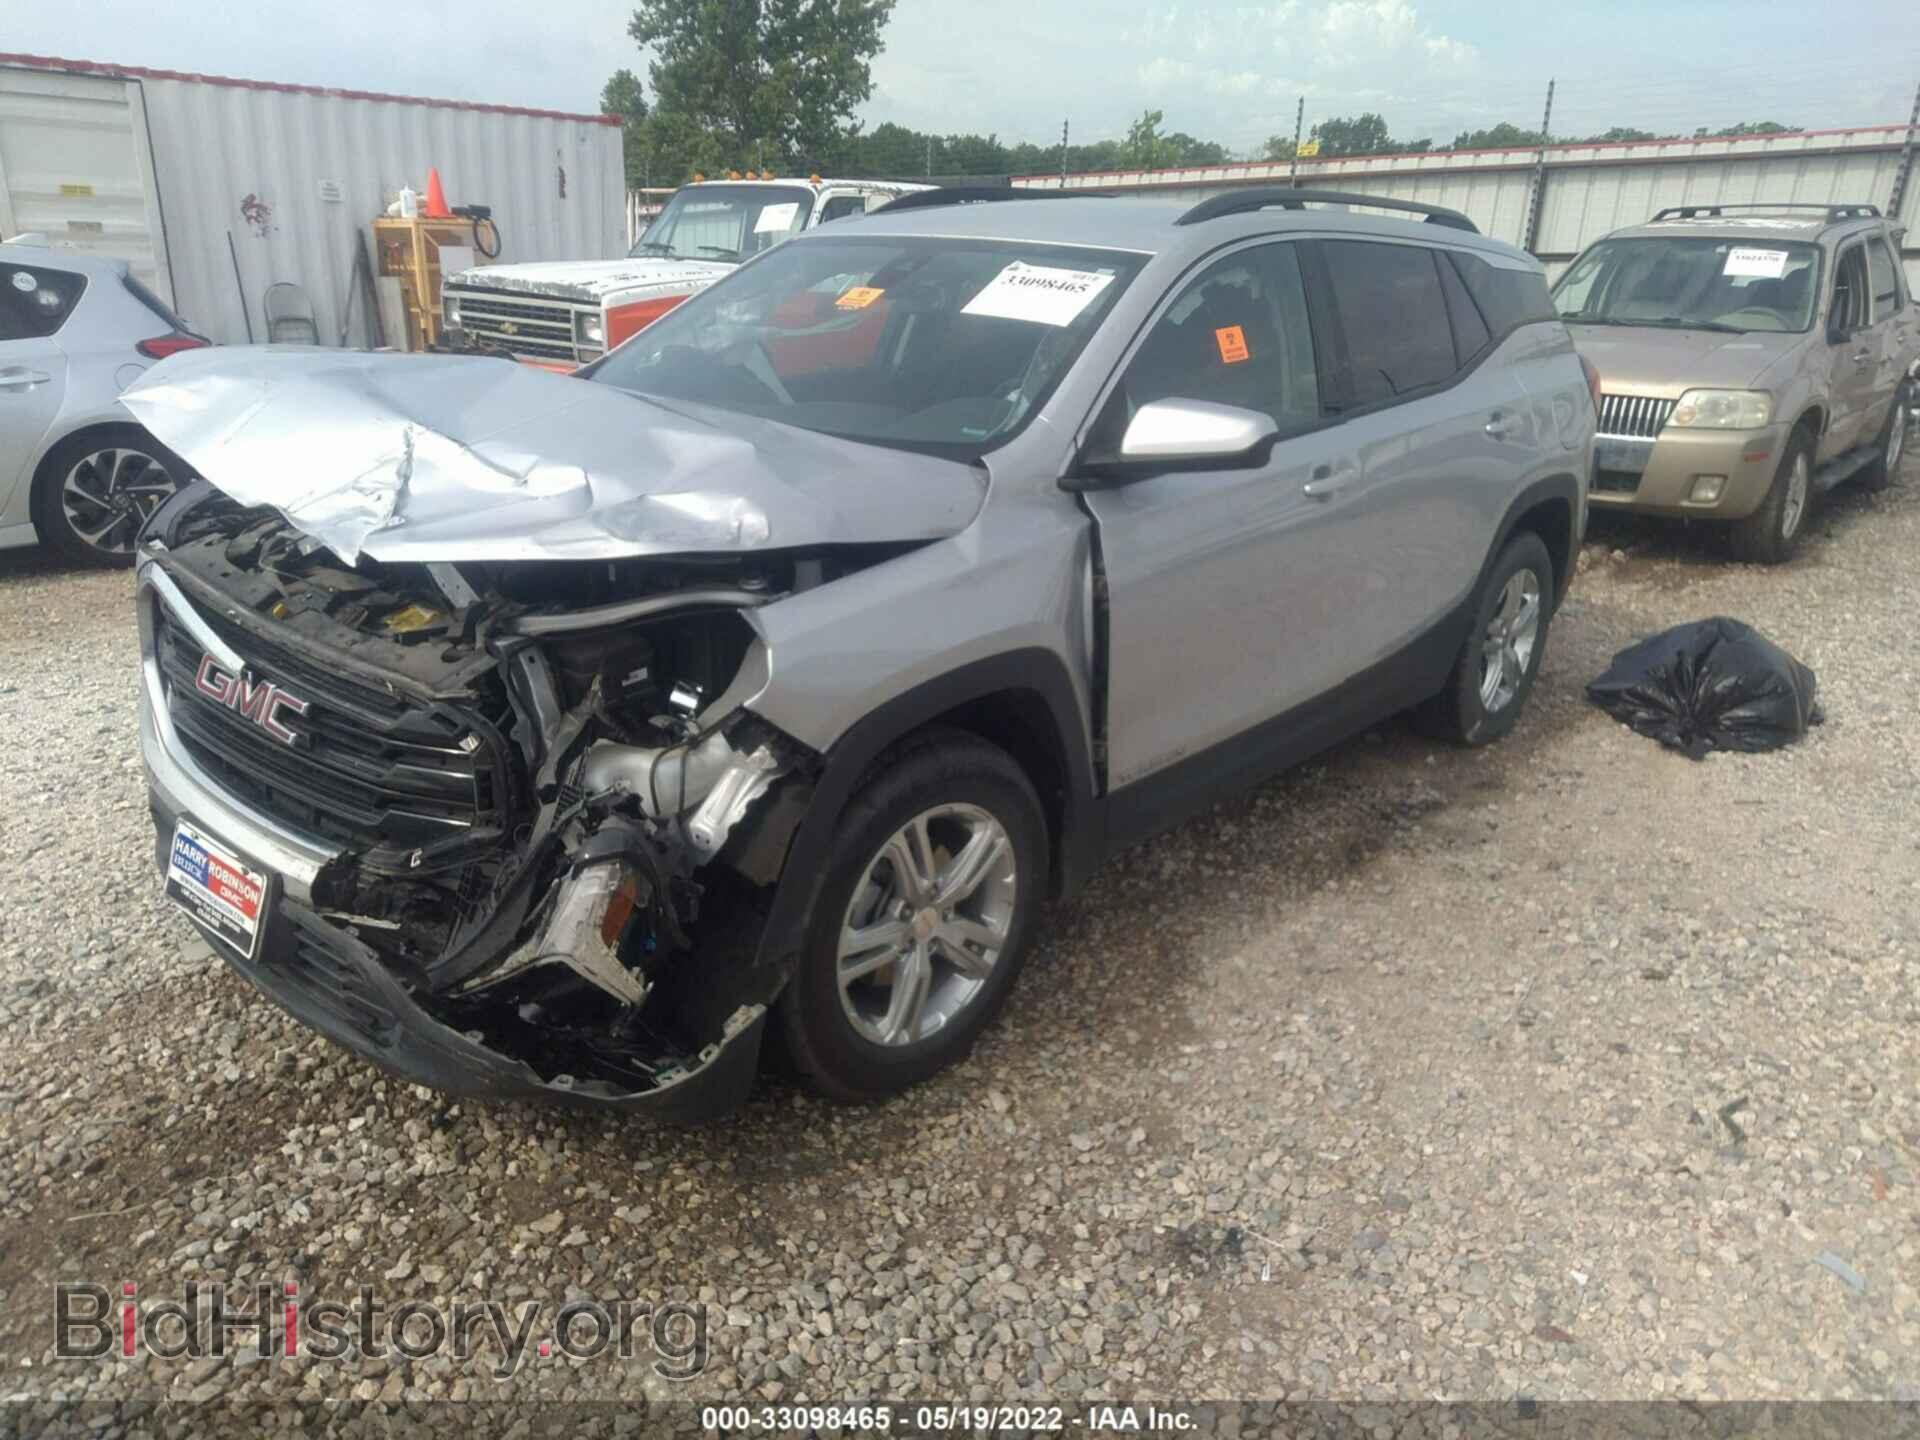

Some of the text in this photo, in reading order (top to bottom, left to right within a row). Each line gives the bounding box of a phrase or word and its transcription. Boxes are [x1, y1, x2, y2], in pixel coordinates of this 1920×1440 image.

[196, 651, 309, 745] GMC
[174, 853, 203, 882] BUICK
[175, 838, 208, 867] HARRY
[208, 861, 259, 903] ROBINSON
[219, 885, 243, 908] GMC
